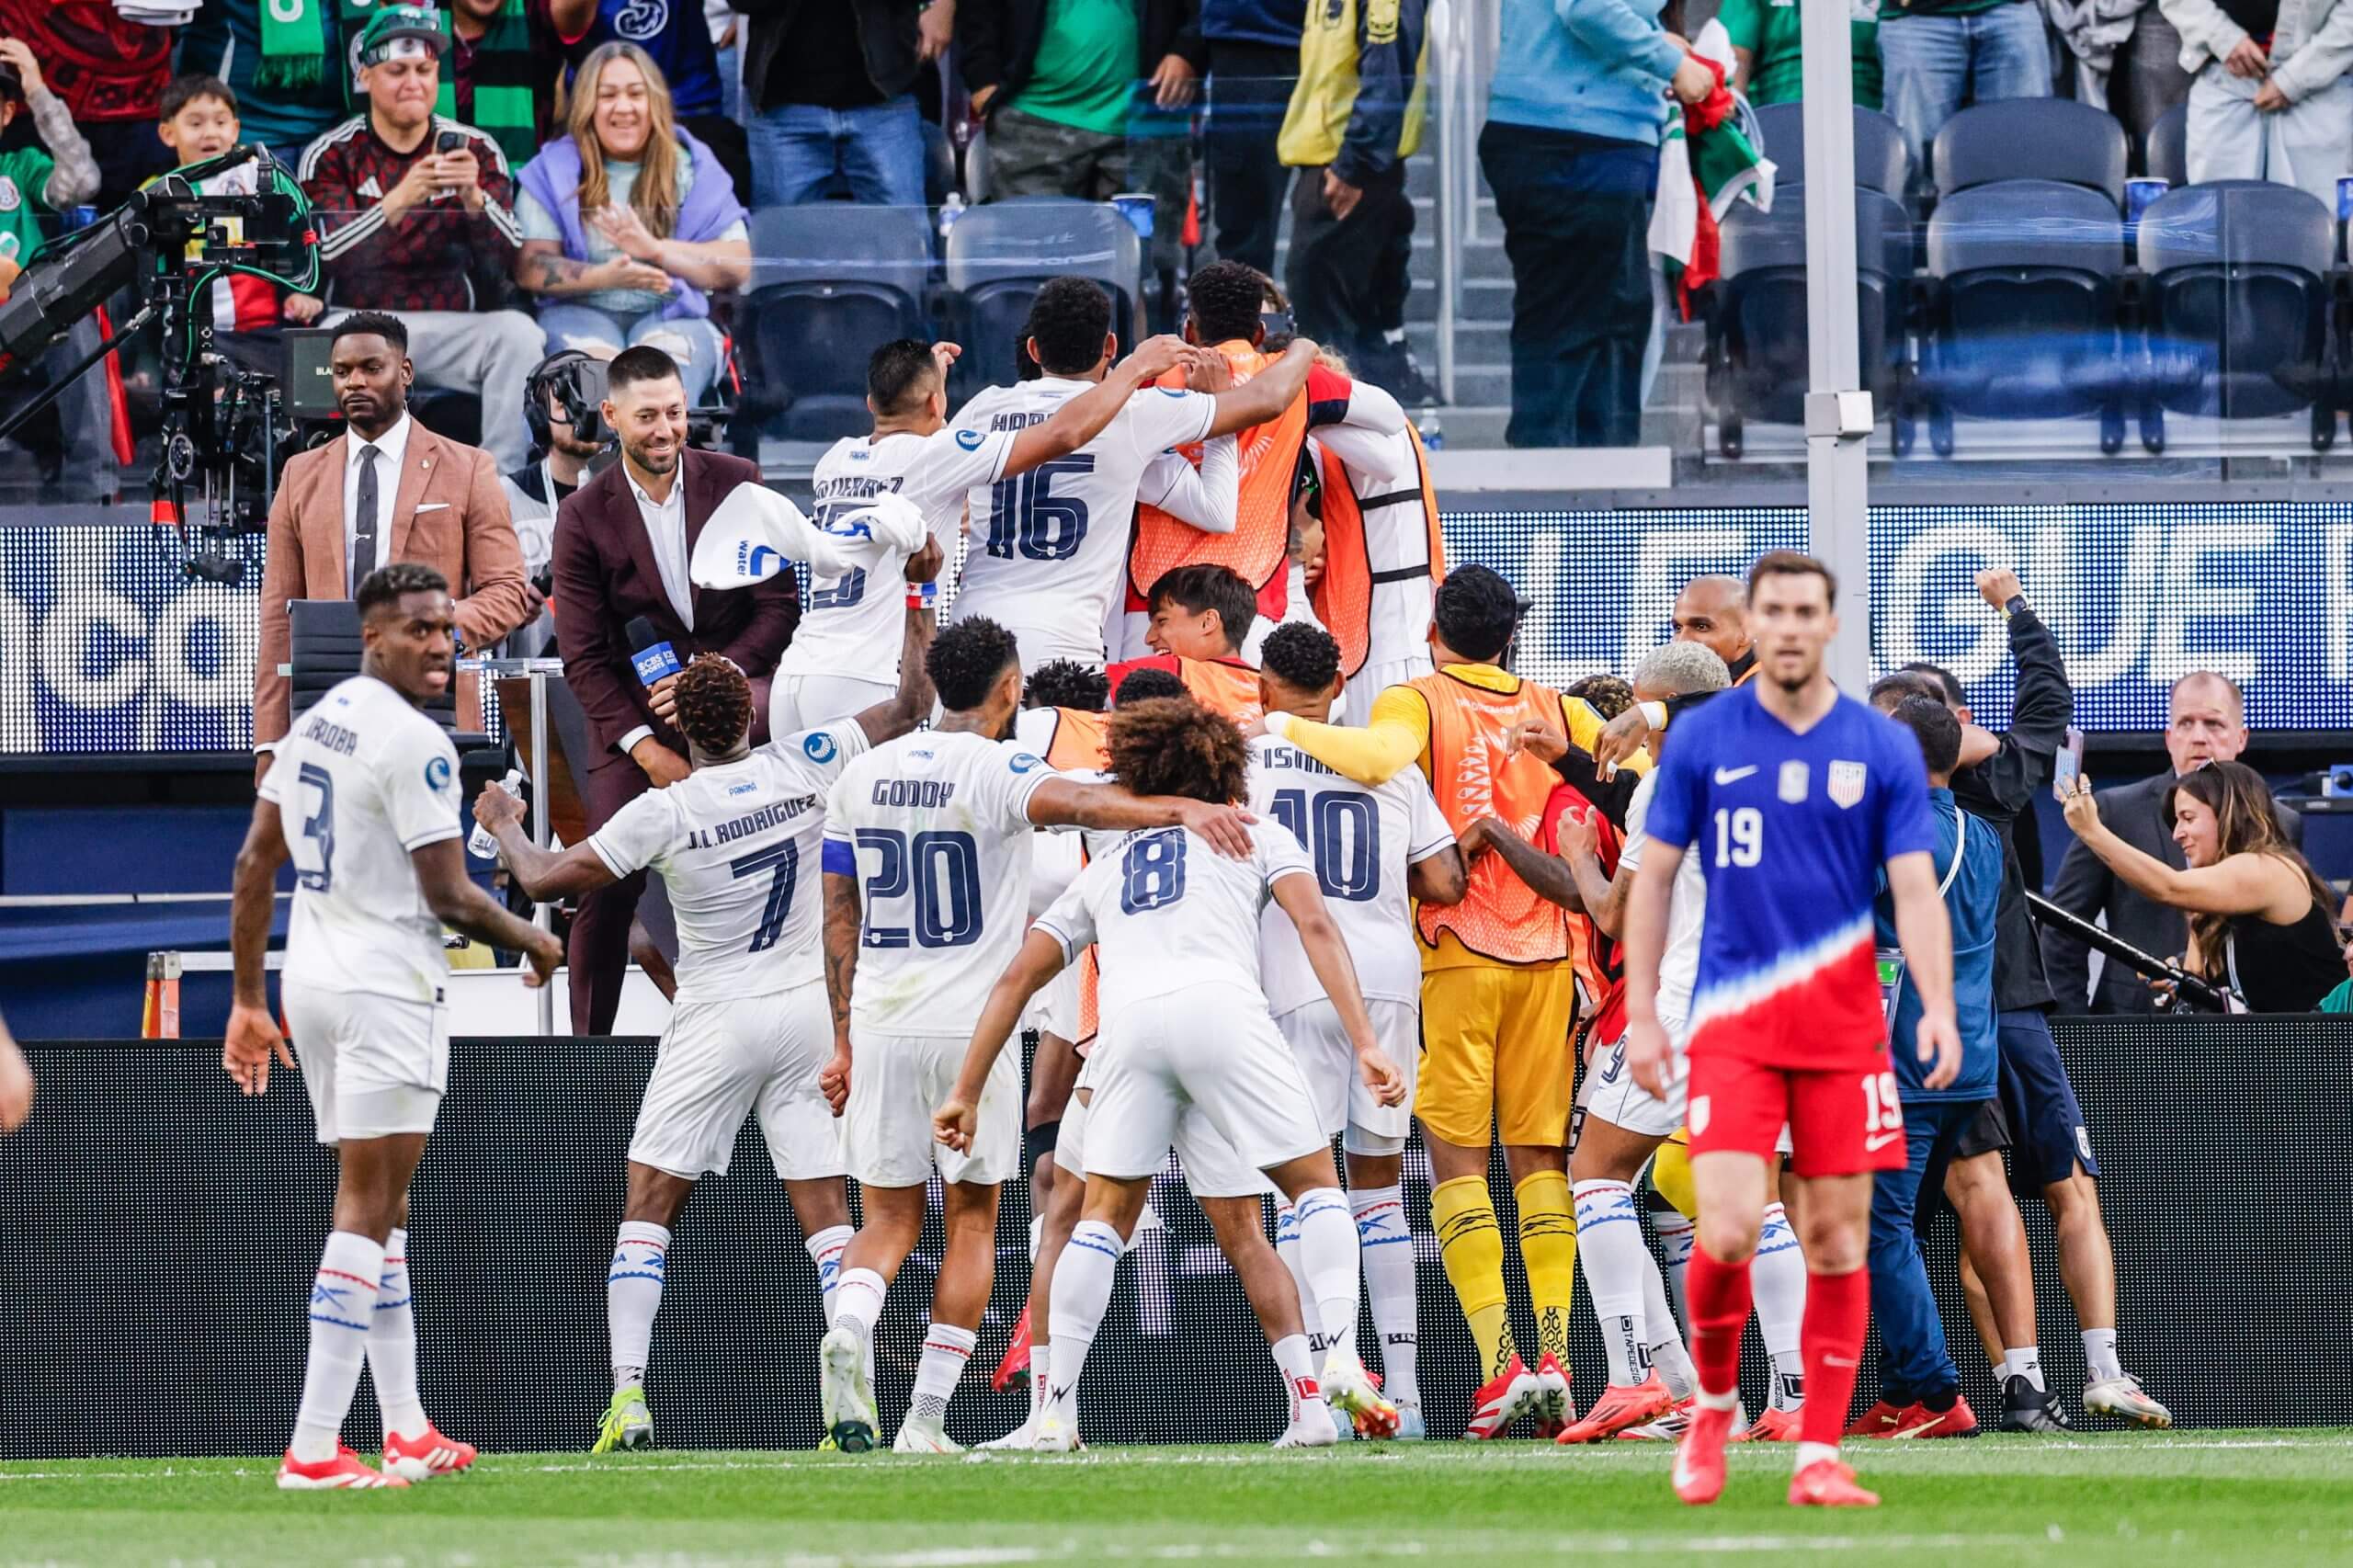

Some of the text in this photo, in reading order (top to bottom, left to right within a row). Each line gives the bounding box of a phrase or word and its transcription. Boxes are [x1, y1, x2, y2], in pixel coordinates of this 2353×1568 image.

[986, 453, 1095, 560] 16
[297, 761, 335, 893] 3
[728, 782, 757, 798] PANAMA
[871, 778, 956, 808] GODOY
[1714, 806, 1764, 869] 19
[729, 835, 799, 953] 7
[855, 827, 983, 949] 20
[1120, 826, 1188, 916] 8
[1269, 789, 1381, 903] 10
[1860, 1071, 1904, 1133] 19
